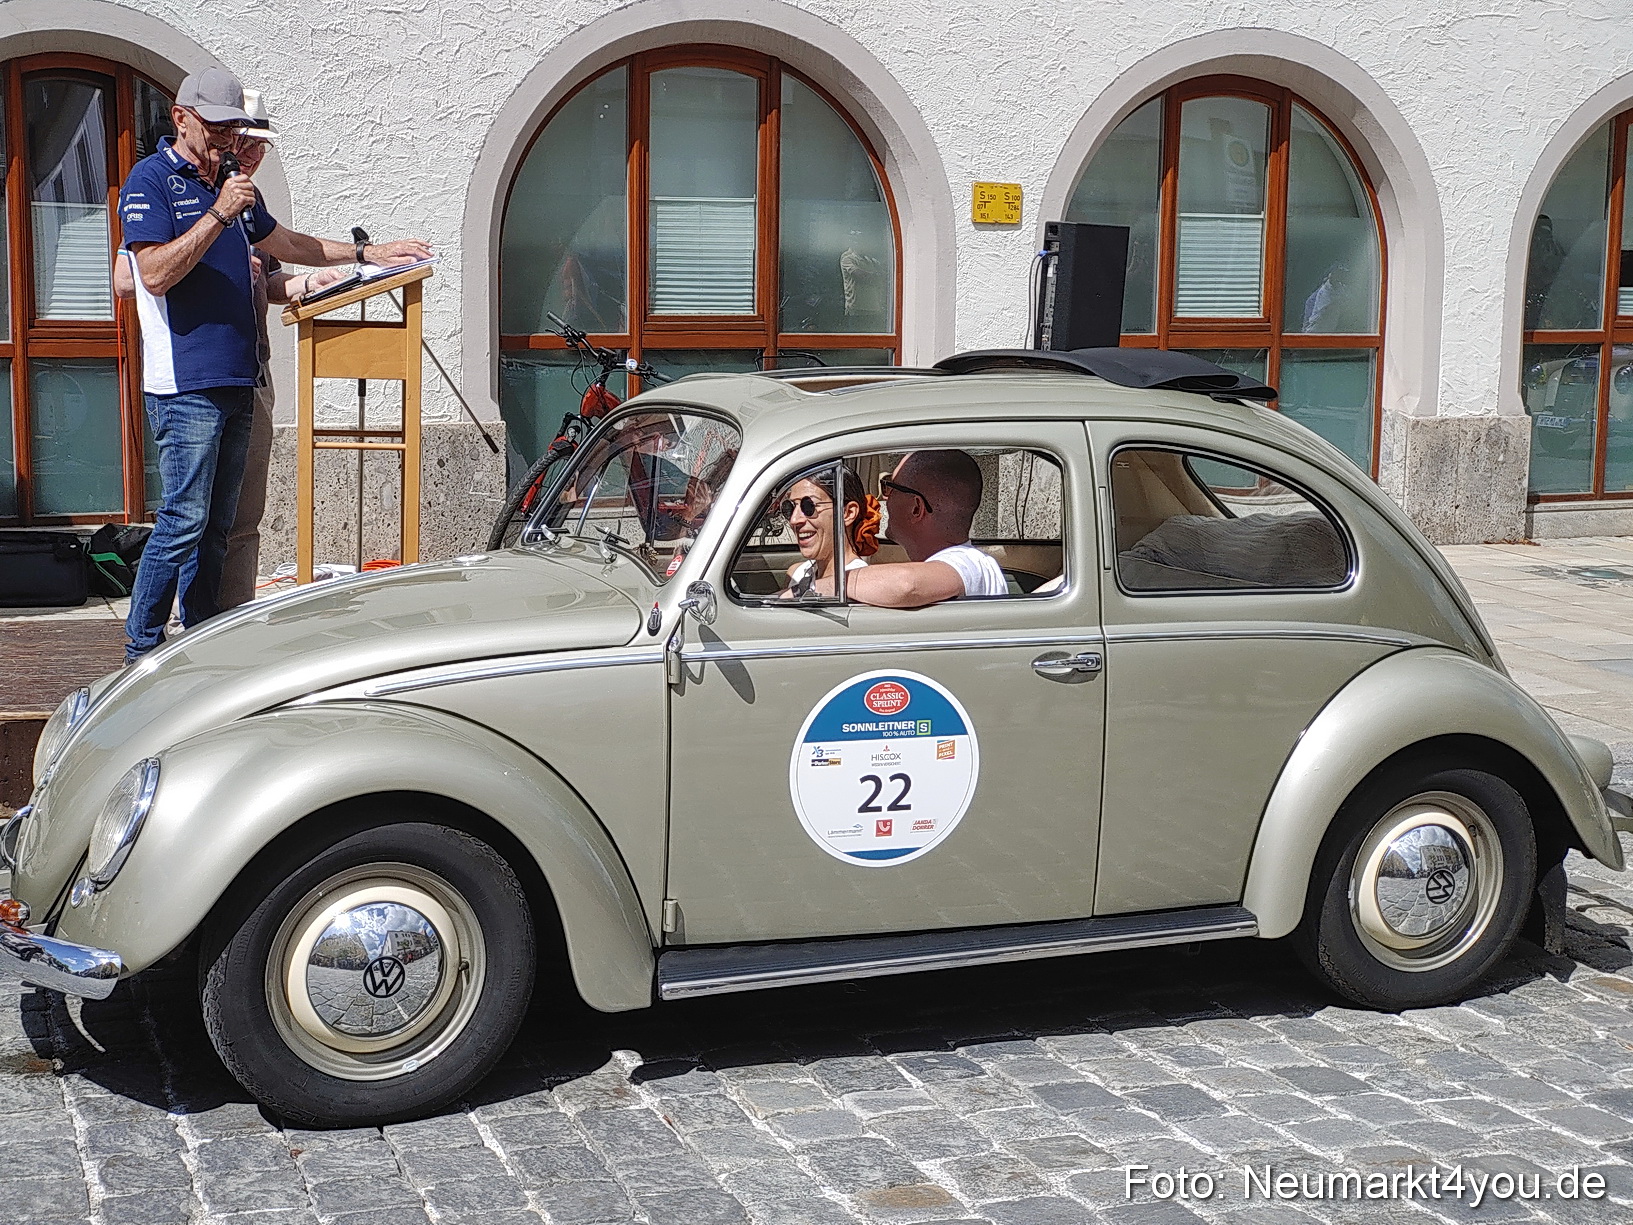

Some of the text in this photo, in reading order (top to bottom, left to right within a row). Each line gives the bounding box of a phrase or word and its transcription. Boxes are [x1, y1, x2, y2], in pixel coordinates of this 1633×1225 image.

[979, 191, 986, 200] S
[1004, 192, 1010, 201] S
[870, 691, 905, 701] CLASSIC
[872, 700, 902, 708] SPRINT
[842, 720, 915, 733] SONNLEITNER
[871, 752, 902, 761] HISCOX
[857, 772, 912, 814] 22
[363, 956, 405, 998] VW
